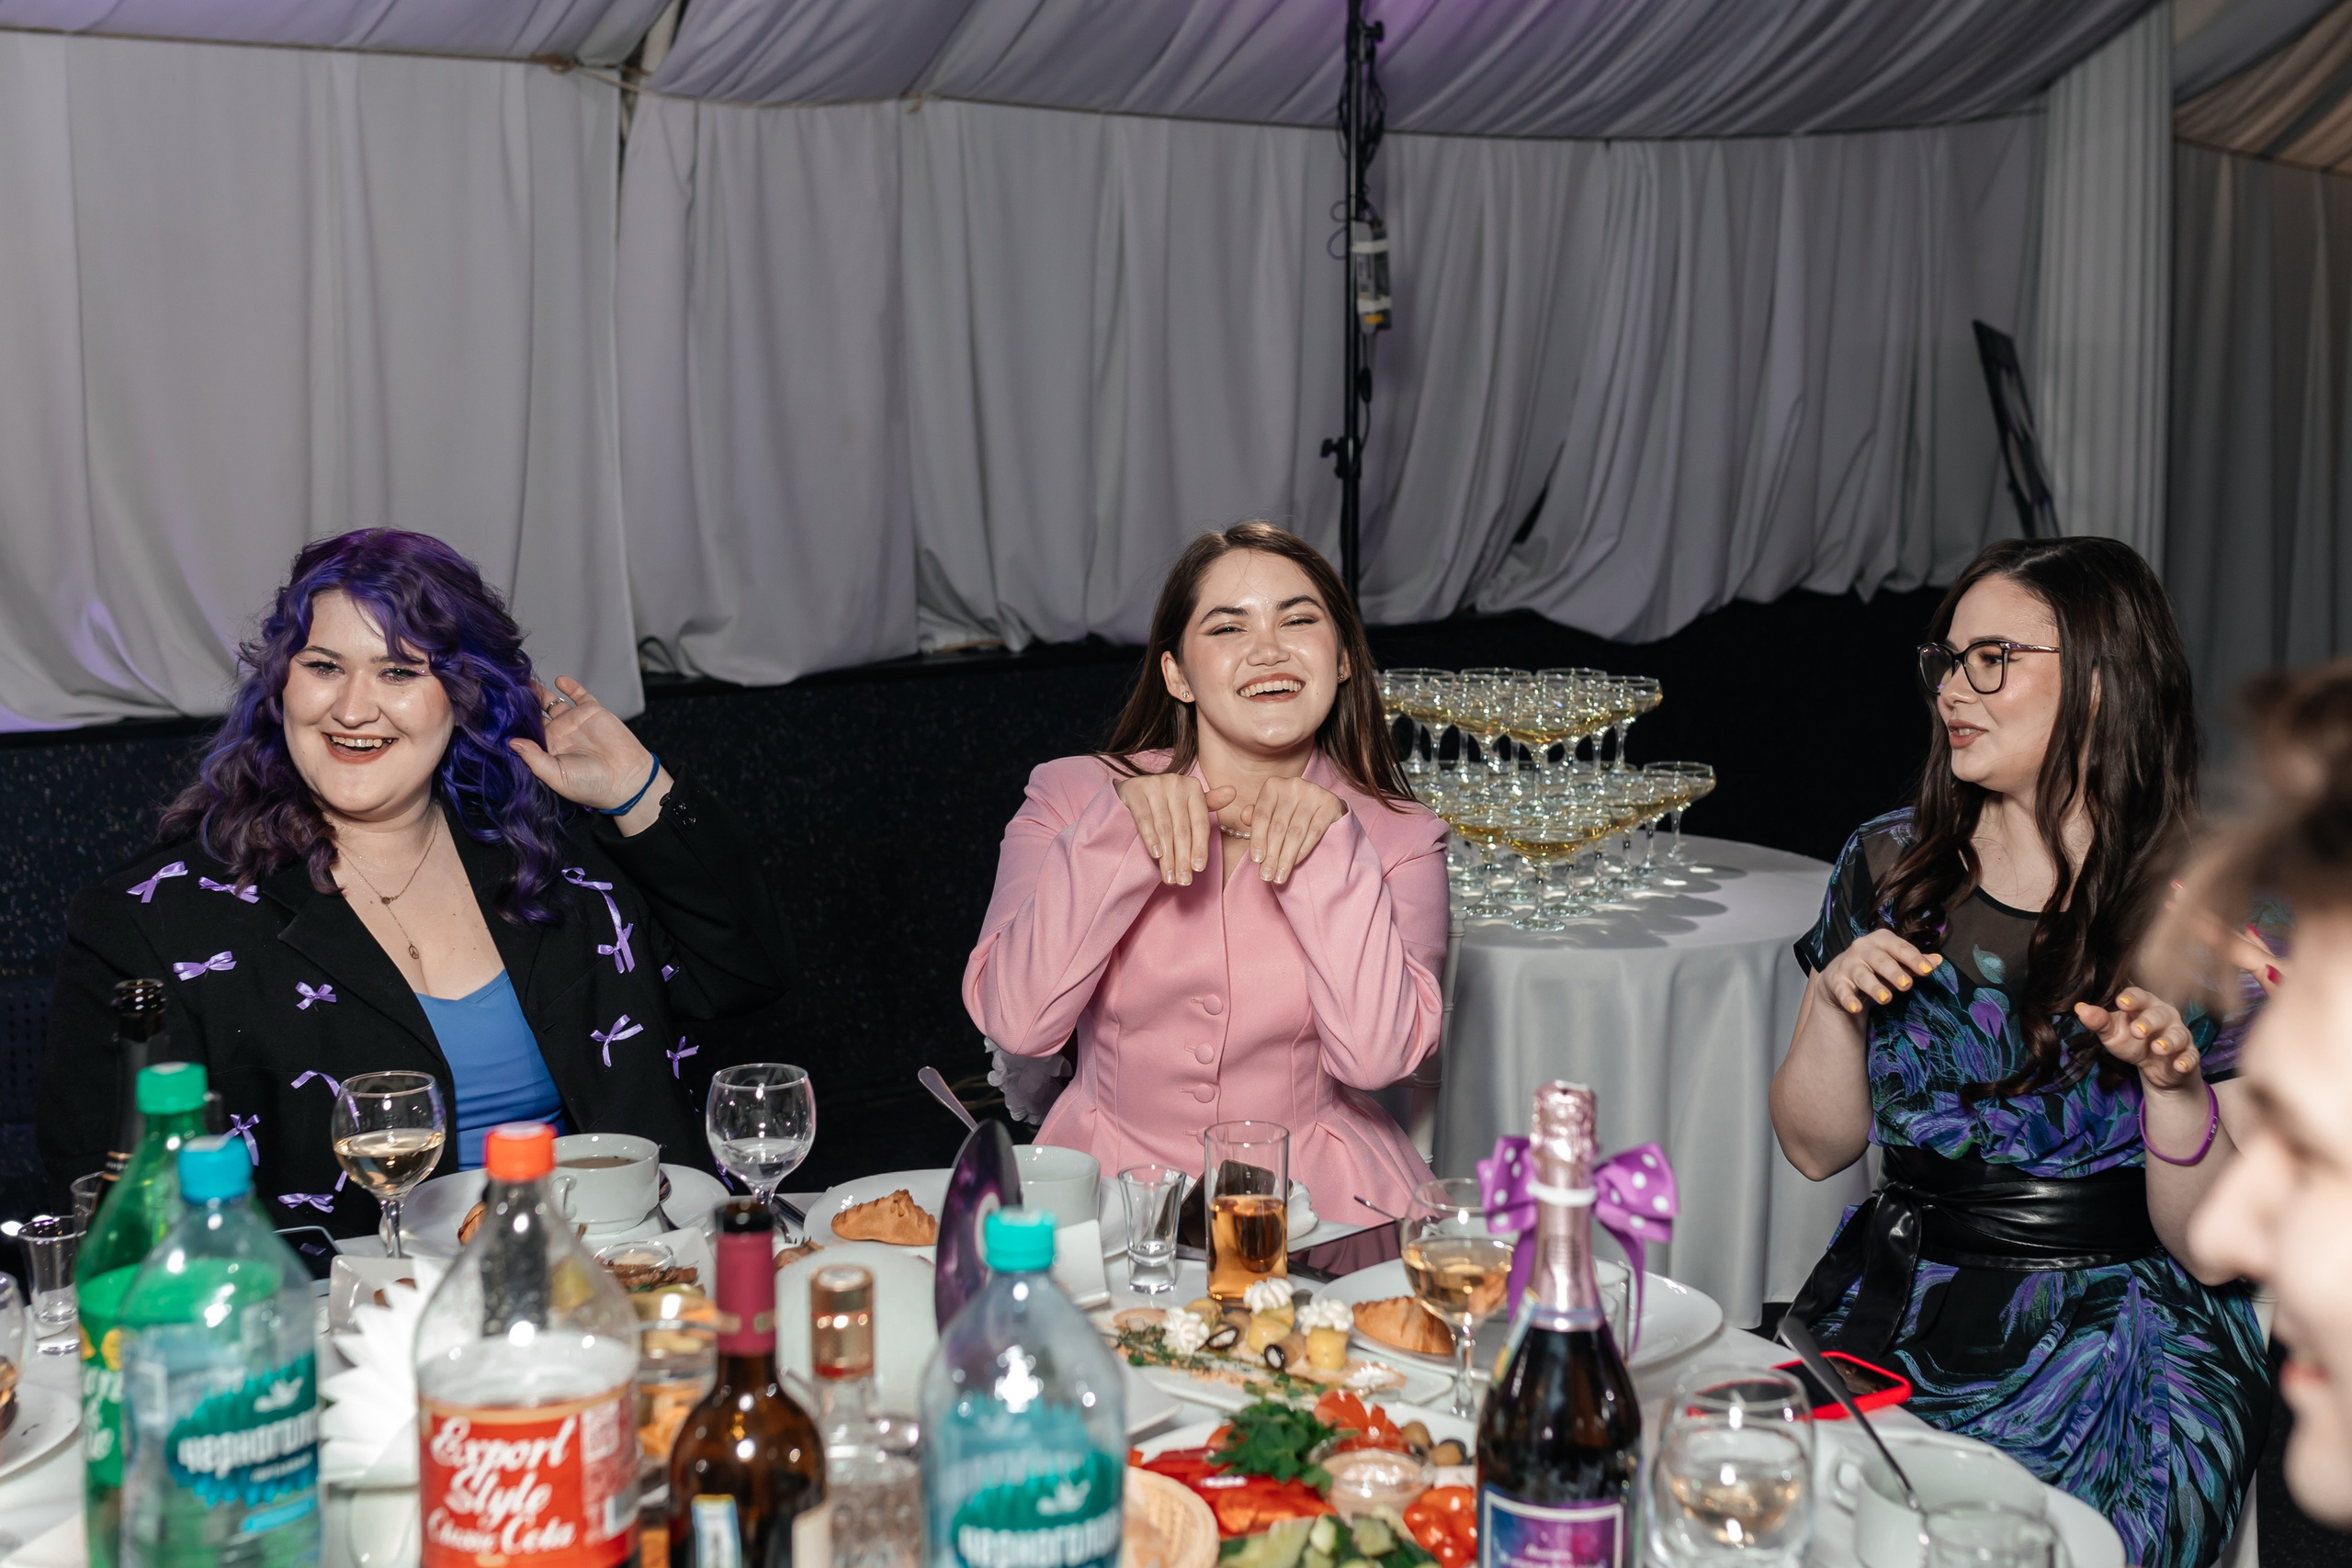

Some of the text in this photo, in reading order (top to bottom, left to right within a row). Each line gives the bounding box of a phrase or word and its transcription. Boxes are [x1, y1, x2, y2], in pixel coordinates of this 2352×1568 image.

[430, 1416, 577, 1490] Export
[445, 1467, 553, 1531] Style
[500, 1514, 577, 1555] Cola
